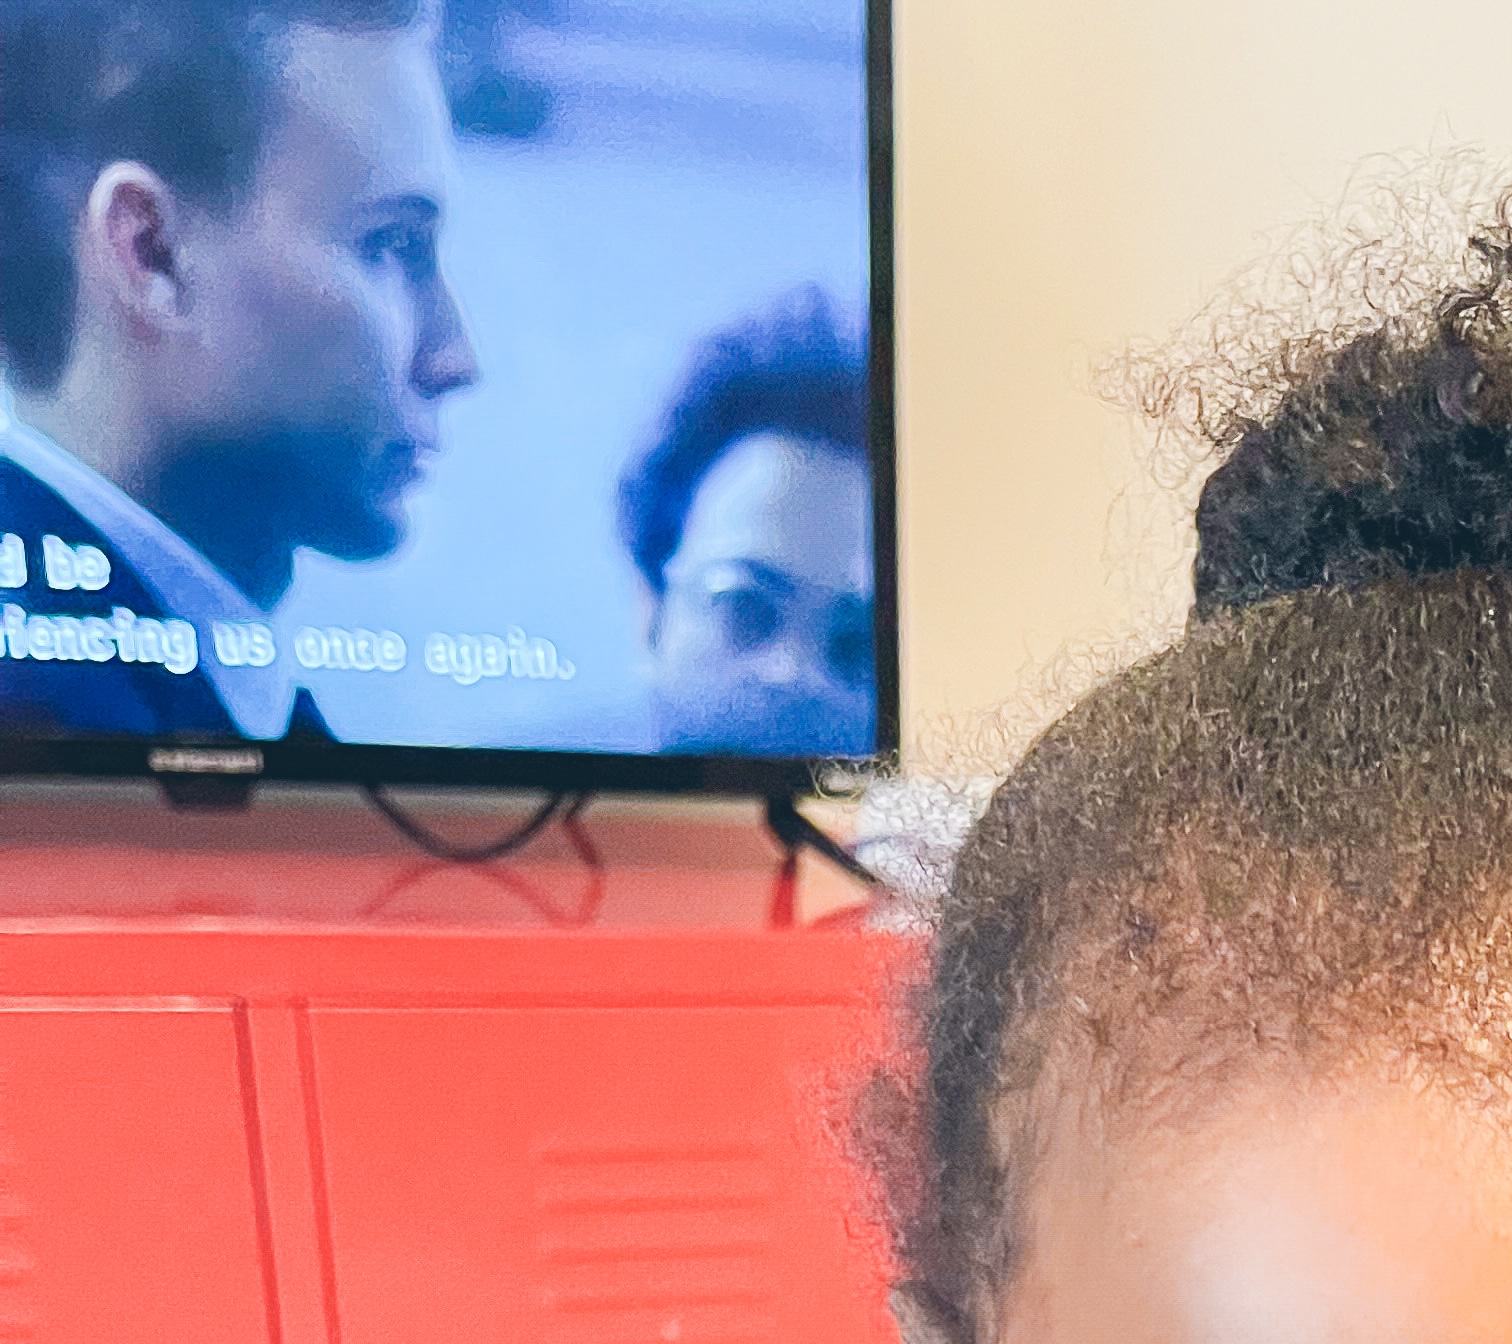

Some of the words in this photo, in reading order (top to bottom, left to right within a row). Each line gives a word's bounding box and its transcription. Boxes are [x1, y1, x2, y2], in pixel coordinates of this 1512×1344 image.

[43, 533, 111, 590] be
[0, 603, 198, 674] iencing
[213, 622, 276, 666] us
[295, 626, 406, 672] once
[425, 624, 575, 685] again.
